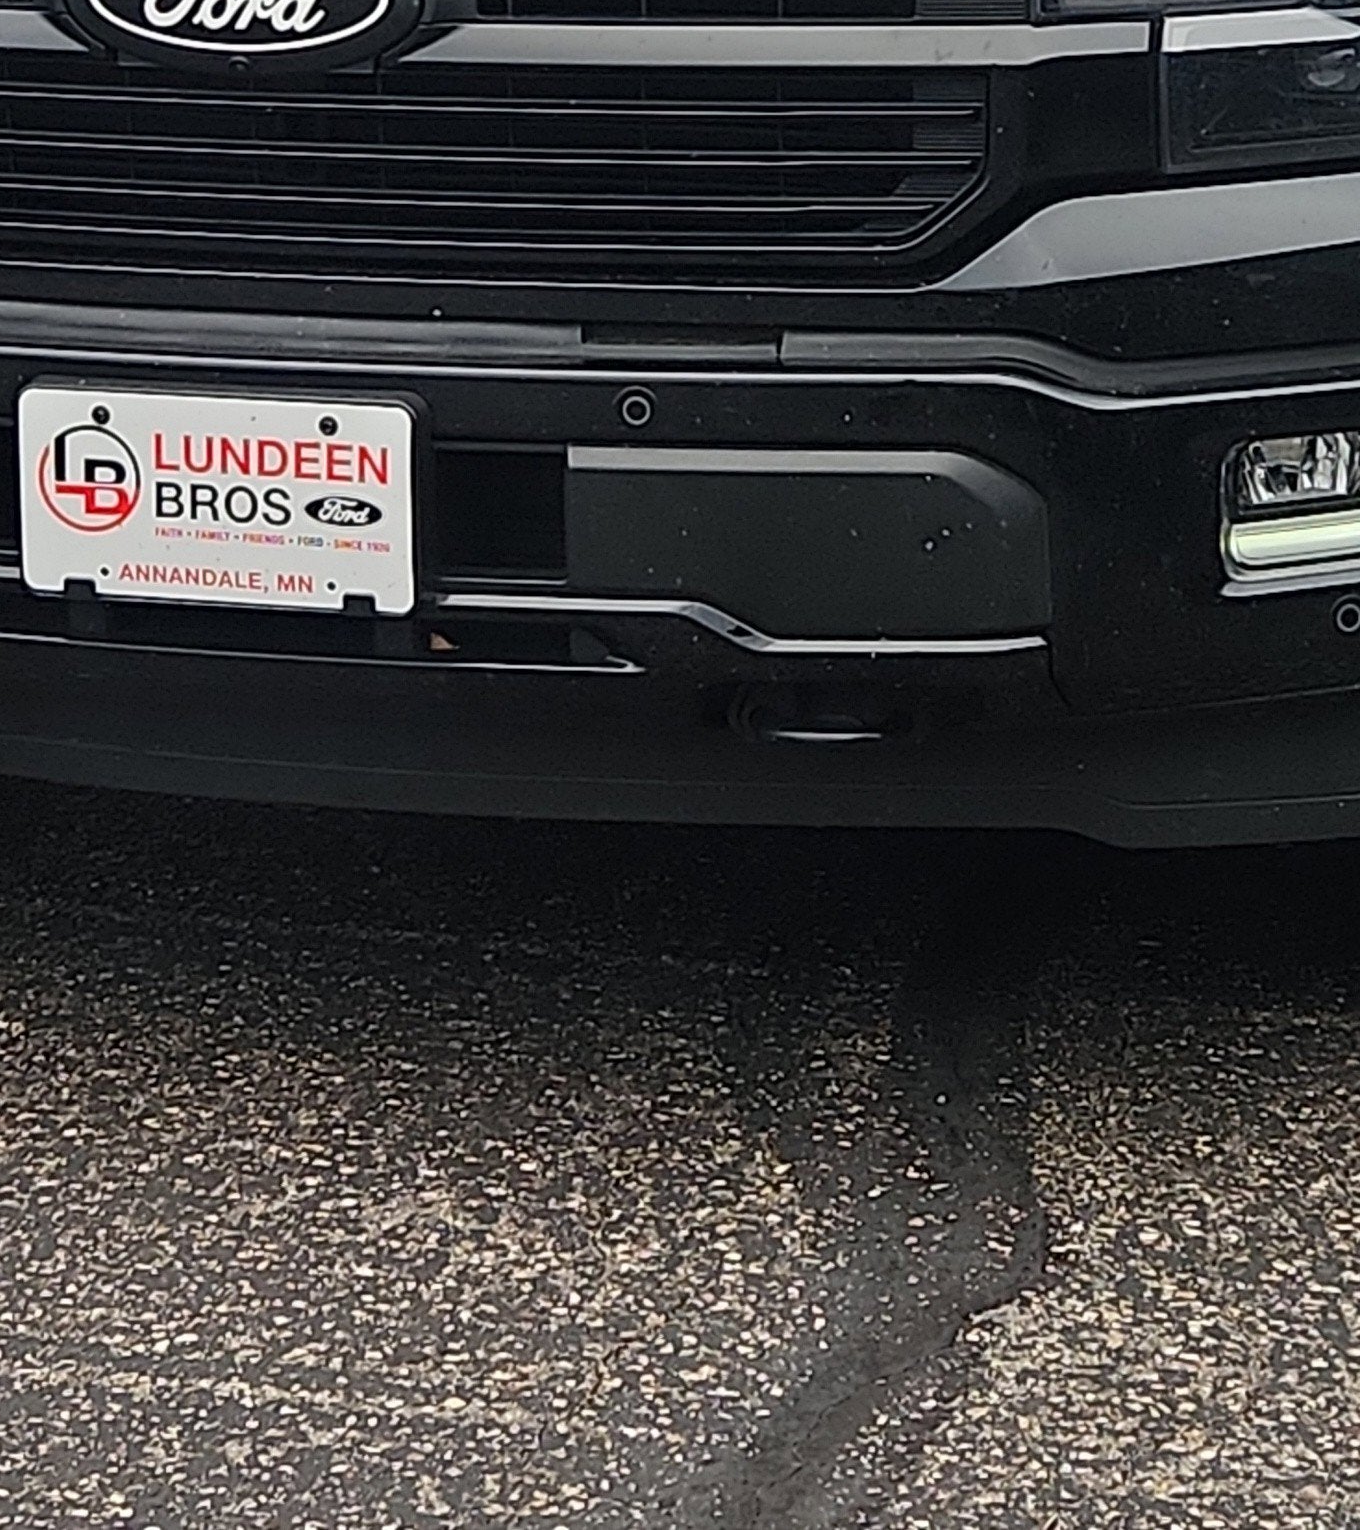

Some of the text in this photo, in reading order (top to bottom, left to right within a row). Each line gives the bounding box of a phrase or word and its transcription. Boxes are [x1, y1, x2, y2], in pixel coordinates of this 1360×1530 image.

[153, 432, 389, 485] LUNDEEN
[155, 481, 292, 526] BROS
[315, 499, 372, 526] Ford
[297, 535, 324, 548] FORD
[118, 562, 314, 593] ANNANDALE, MN
